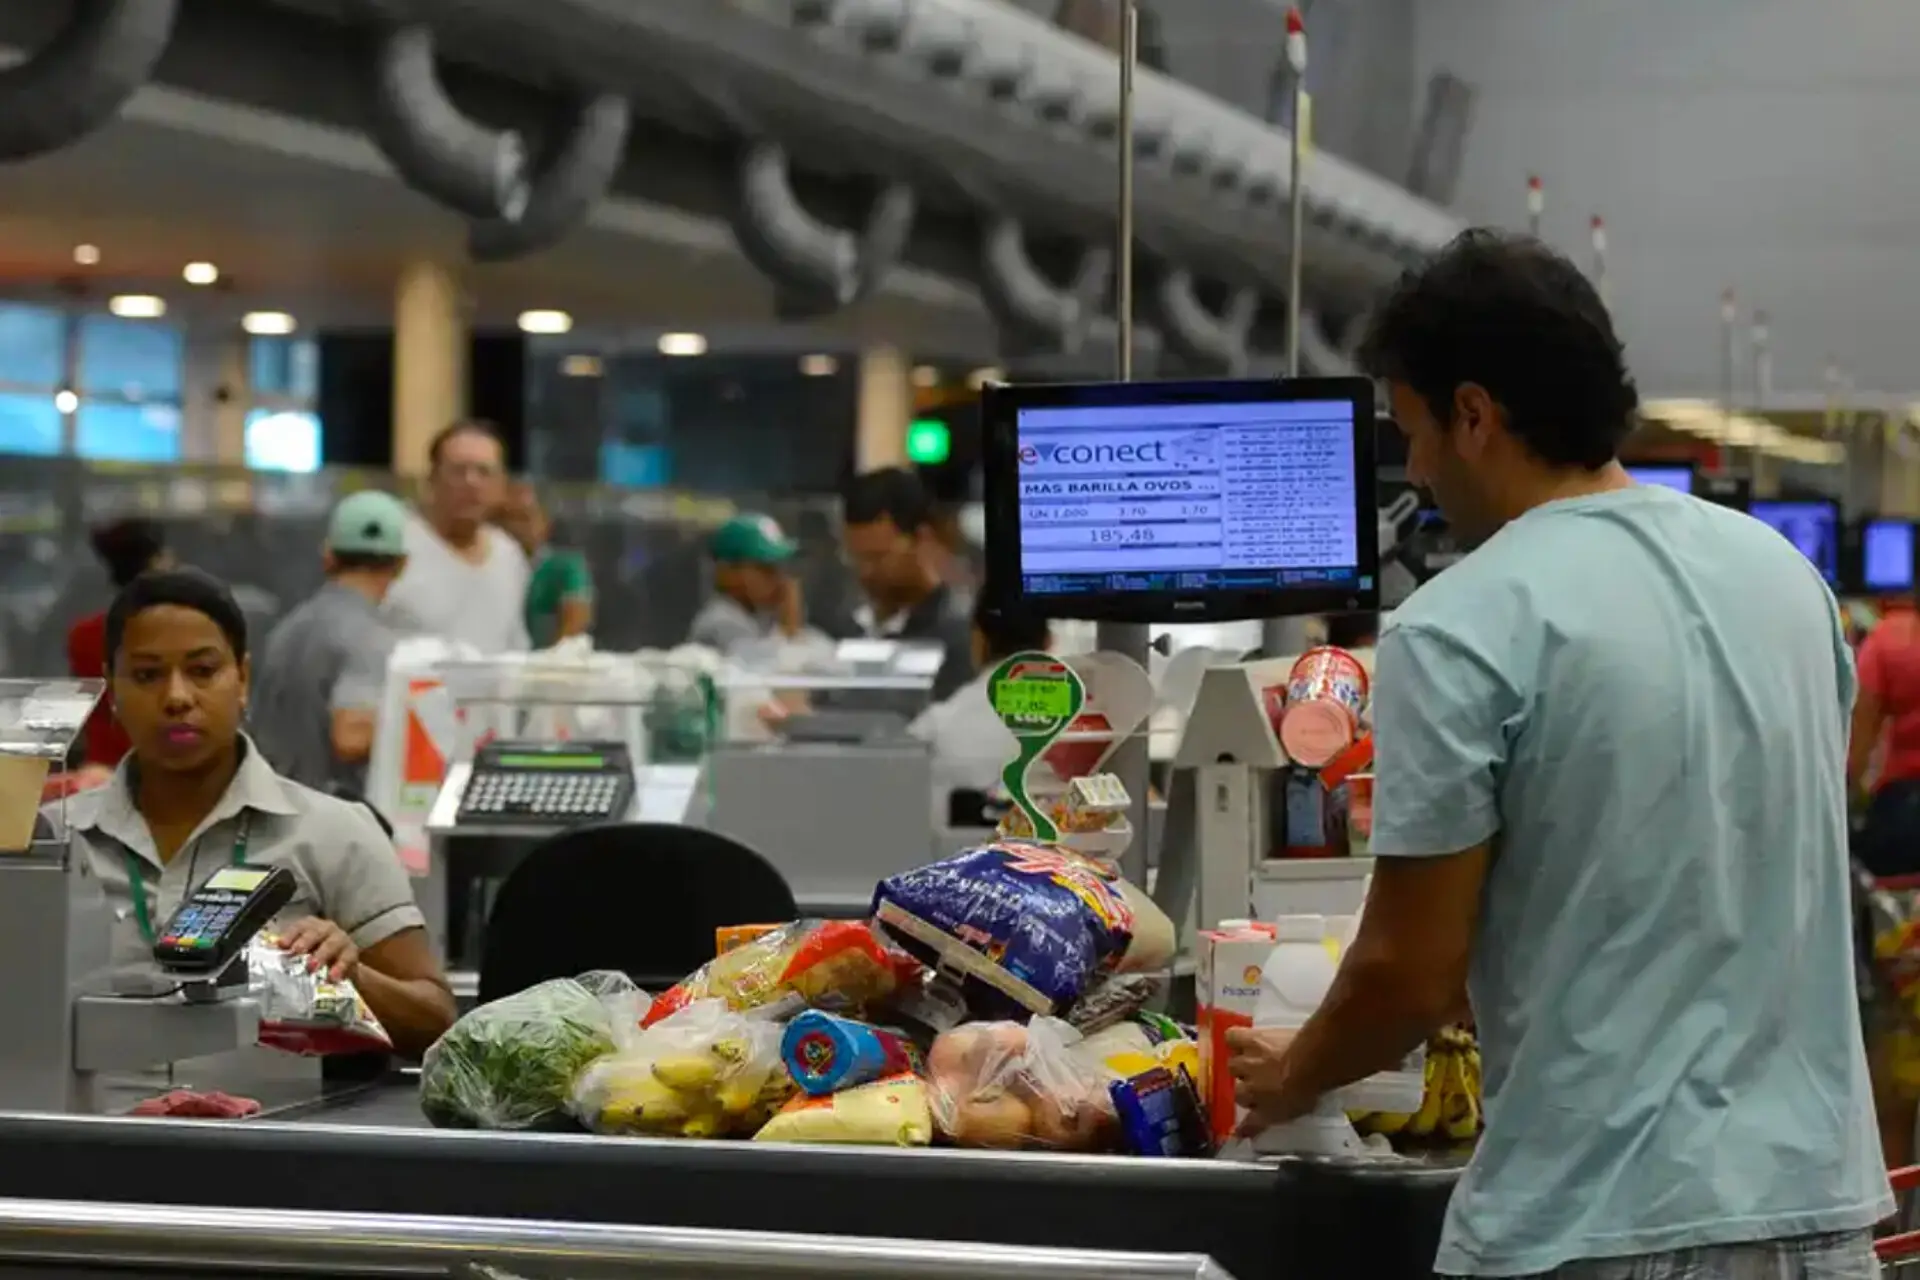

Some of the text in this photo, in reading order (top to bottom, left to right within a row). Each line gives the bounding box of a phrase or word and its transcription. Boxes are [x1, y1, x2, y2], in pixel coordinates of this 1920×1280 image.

[1025, 482, 1062, 494] MAS
[1068, 480, 1139, 493] BARILLA
[1144, 480, 1192, 491] OVOS
